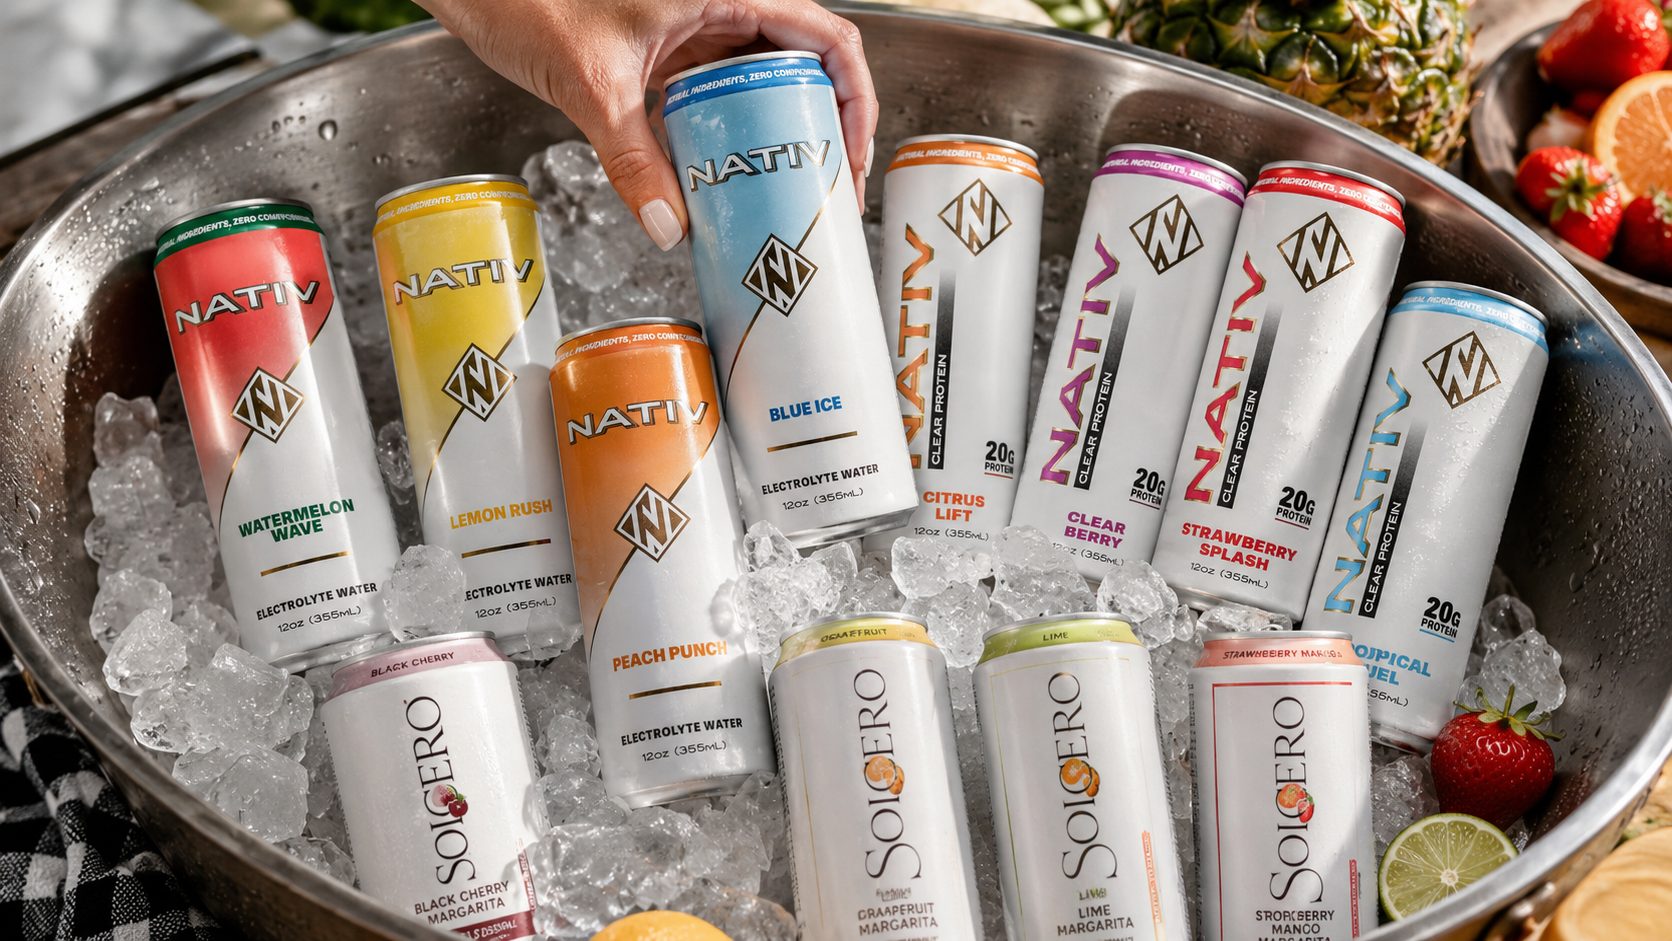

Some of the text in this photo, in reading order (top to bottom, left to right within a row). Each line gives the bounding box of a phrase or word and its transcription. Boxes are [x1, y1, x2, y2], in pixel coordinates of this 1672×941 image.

[749, 70, 773, 82] ZERO
[687, 139, 831, 193] NATIV
[455, 192, 478, 202] ZERO
[232, 214, 257, 226] ZERO
[393, 259, 534, 305] NATIV
[174, 281, 320, 335] NATIV
[631, 333, 656, 342] ZERO
[1040, 233, 1120, 486] NATIV
[1184, 250, 1267, 504] NATIV
[567, 399, 709, 446] NATIV
[769, 395, 843, 422] BLUE ICE
[931, 354, 947, 465] CLEAR PROTEIN
[1079, 371, 1113, 485] CLEAR PROTEIN
[985, 440, 1015, 465] 20G
[1222, 389, 1258, 503] CLEAR PROTEIN
[761, 463, 879, 495] ELECTROLYTE WATER
[984, 462, 1014, 474] PROTEIN
[1133, 467, 1166, 496] 20G
[923, 491, 985, 508] CITRUS
[1130, 488, 1162, 505] PROTEIN
[1279, 486, 1315, 516] 20G
[1323, 367, 1412, 614] NATIV
[238, 498, 355, 538] WATERMELON
[450, 499, 553, 530] LEMON RUSH
[935, 508, 973, 522] LIFT
[1067, 511, 1126, 535] CLEAR
[1276, 507, 1312, 526] PROTEIN
[270, 519, 324, 542] WAVE
[1064, 525, 1123, 549] BERRY
[1181, 522, 1297, 562] STRAWBERRY
[1199, 543, 1270, 571] SPLASH
[1364, 501, 1402, 613] CLEAR PROTEIN
[256, 582, 377, 621] ELECTROLYTE WATER
[464, 573, 572, 602] ECTROLYTE WATER
[1424, 596, 1461, 628] 20G
[1042, 631, 1069, 642] LIME
[1421, 618, 1458, 639] PROTEIN
[371, 652, 454, 678] BLACK CHERRY
[612, 640, 728, 672] PEACH PUNCH
[1366, 664, 1399, 686] UEL
[621, 718, 743, 746] ELECTROLYTE WATER
[414, 880, 509, 915] BLACK CHERRY
[427, 897, 506, 925] MARGARITA
[1078, 904, 1111, 919] LIME
[859, 916, 938, 936] MARGARITA
[1057, 917, 1134, 936] MARGARITA
